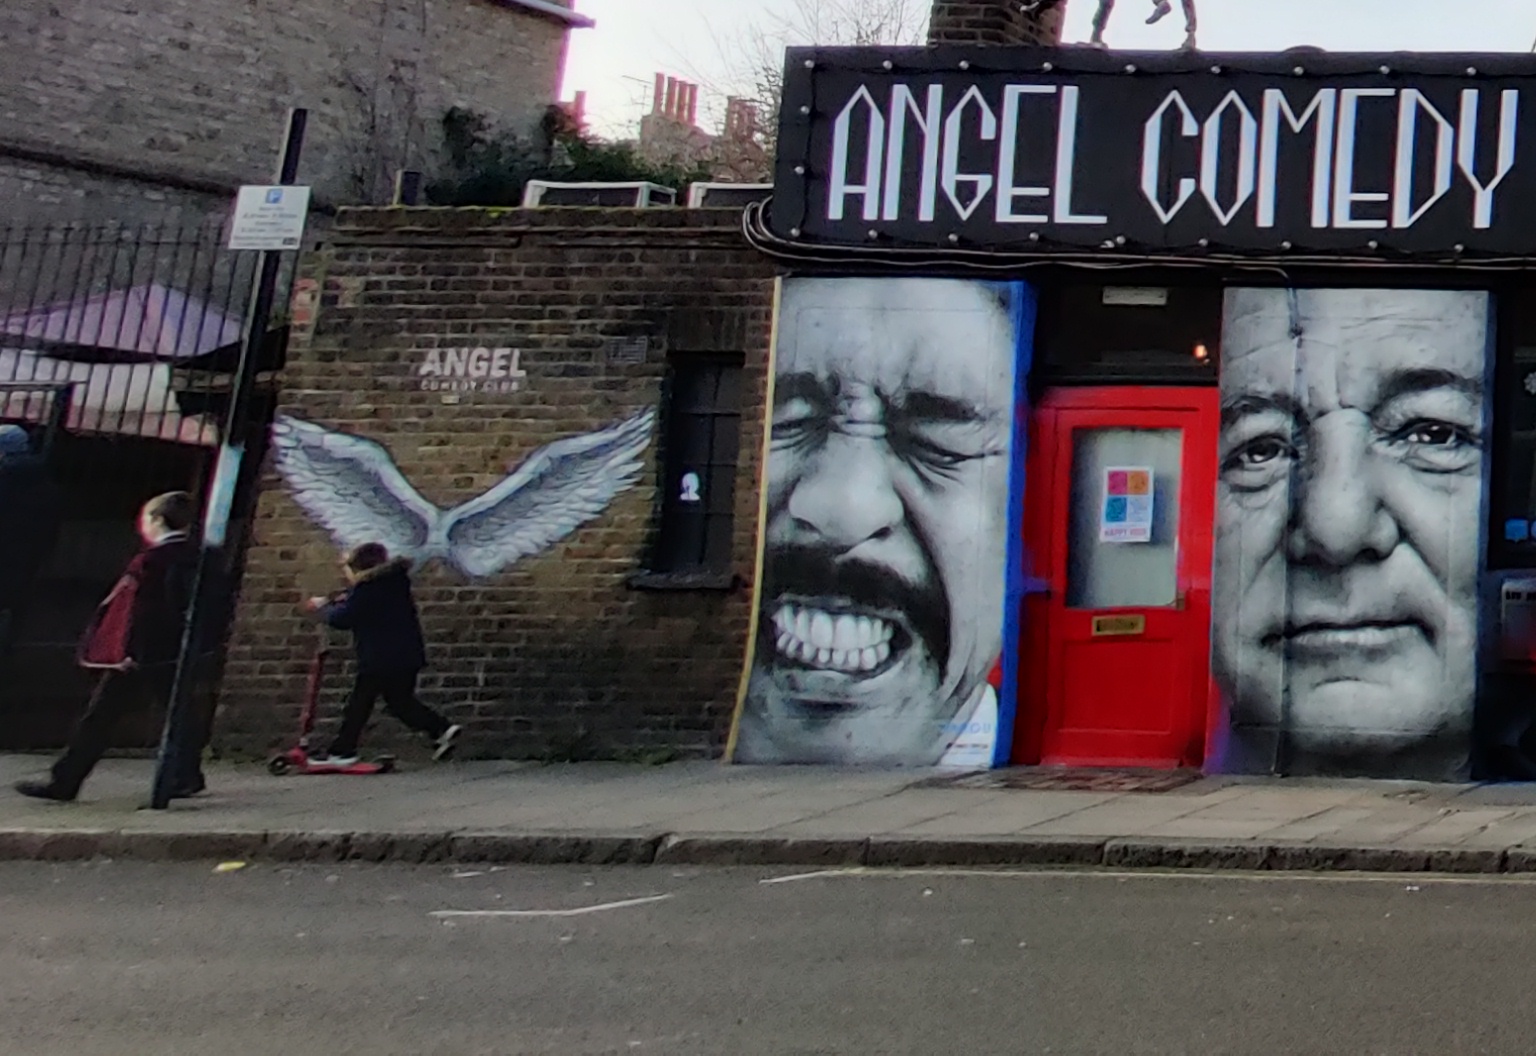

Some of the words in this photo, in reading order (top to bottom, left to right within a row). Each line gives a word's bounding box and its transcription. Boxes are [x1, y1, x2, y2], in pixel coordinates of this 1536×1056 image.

[828, 84, 1107, 224] ANGEL
[1141, 88, 1519, 229] COMEDY
[419, 346, 527, 377] ANGEL
